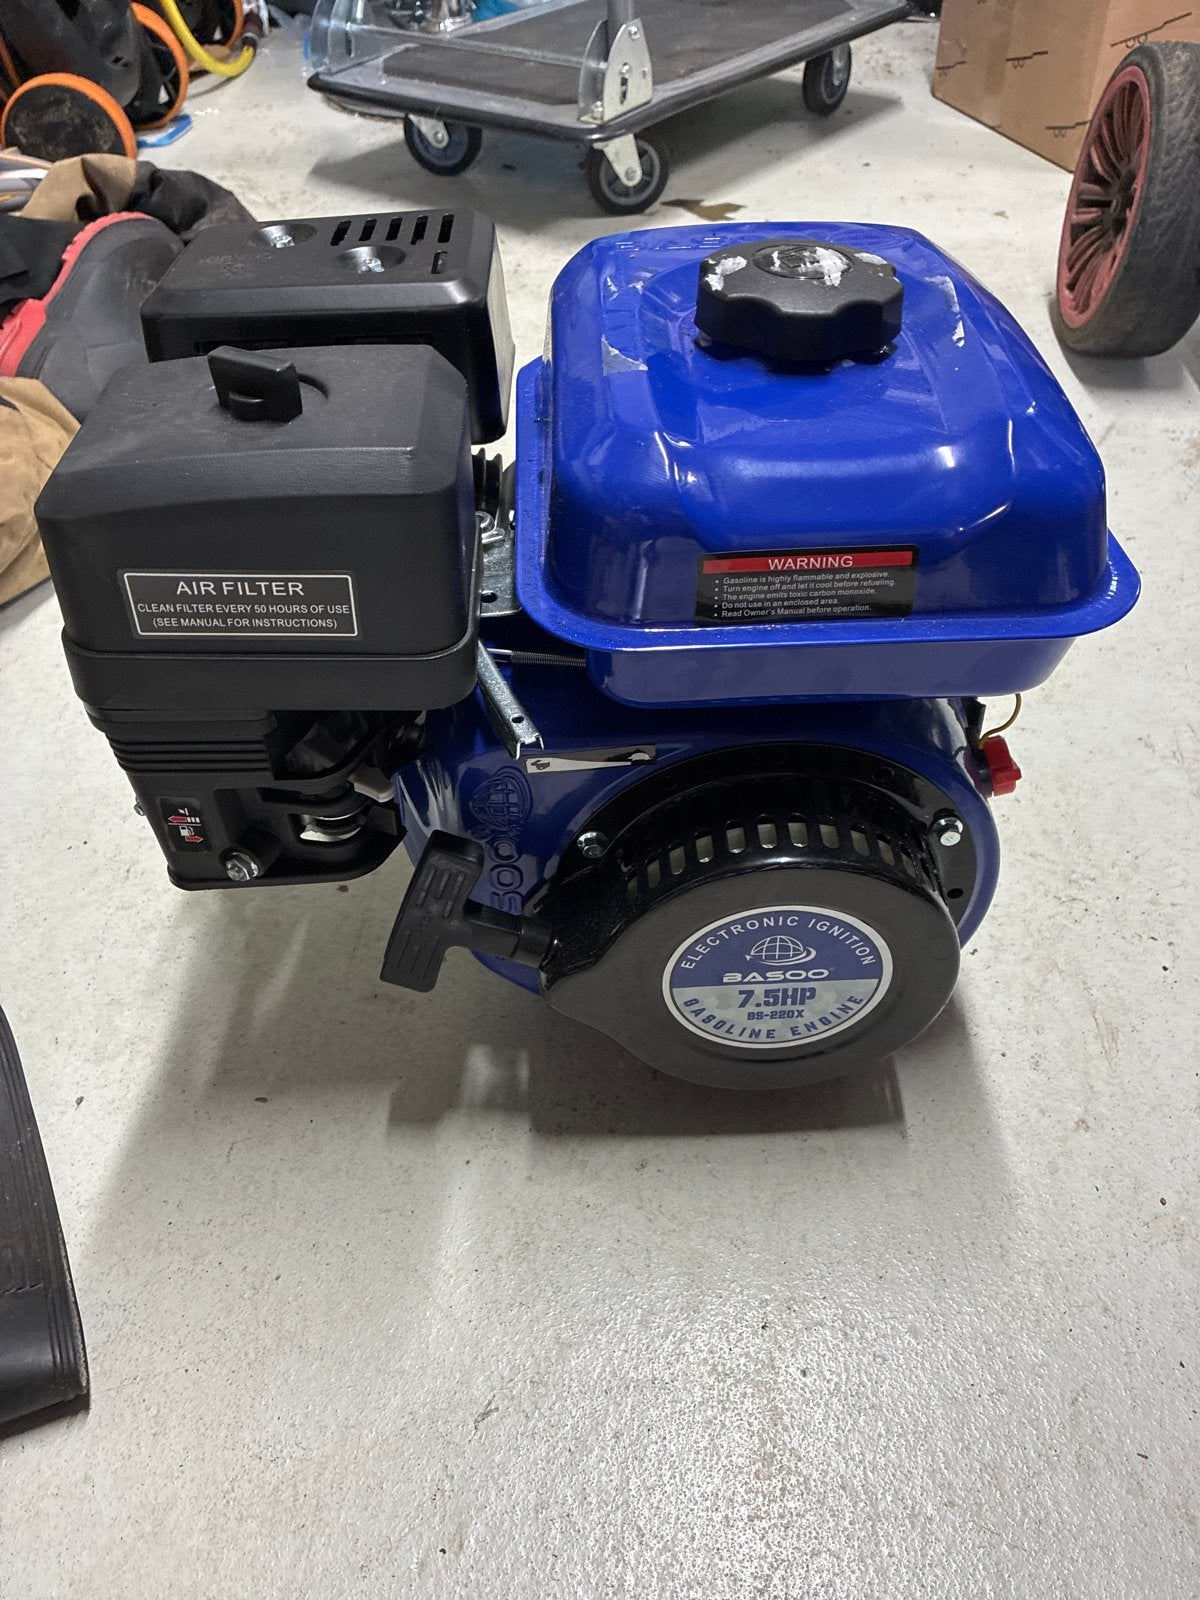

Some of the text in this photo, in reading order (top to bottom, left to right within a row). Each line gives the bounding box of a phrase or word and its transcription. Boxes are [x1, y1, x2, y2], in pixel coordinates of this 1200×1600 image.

[768, 556, 853, 570] WARNING
[767, 575, 791, 584] highly
[792, 573, 833, 581] flammable
[834, 572, 849, 580] and
[851, 571, 890, 580] explosive.
[176, 581, 305, 596] AIR FILTER
[742, 584, 768, 593] engine
[769, 583, 780, 591] off
[833, 580, 859, 588] before
[860, 579, 896, 587] refueling.
[738, 592, 765, 601] engine
[808, 589, 836, 597] carbon
[837, 588, 877, 596] monoxide.
[137, 603, 350, 614] CLEAN FILTER EVERY 50 HOURS OF USE
[721, 601, 733, 609] Do
[743, 608, 776, 617] Owner's
[776, 607, 805, 615] Manual
[806, 606, 832, 614] before
[832, 605, 872, 613] operation.
[152, 617, 338, 629] (SEE MANUAL FOR INSTRUCTIONS)
[681, 916, 876, 969] ELECTRONIC IGNITION
[722, 969, 829, 983] BASOO
[738, 987, 817, 1008] 7.5HP
[683, 995, 864, 1039] GASOLINE ENGINE
[747, 1009, 805, 1020] BS-220X
